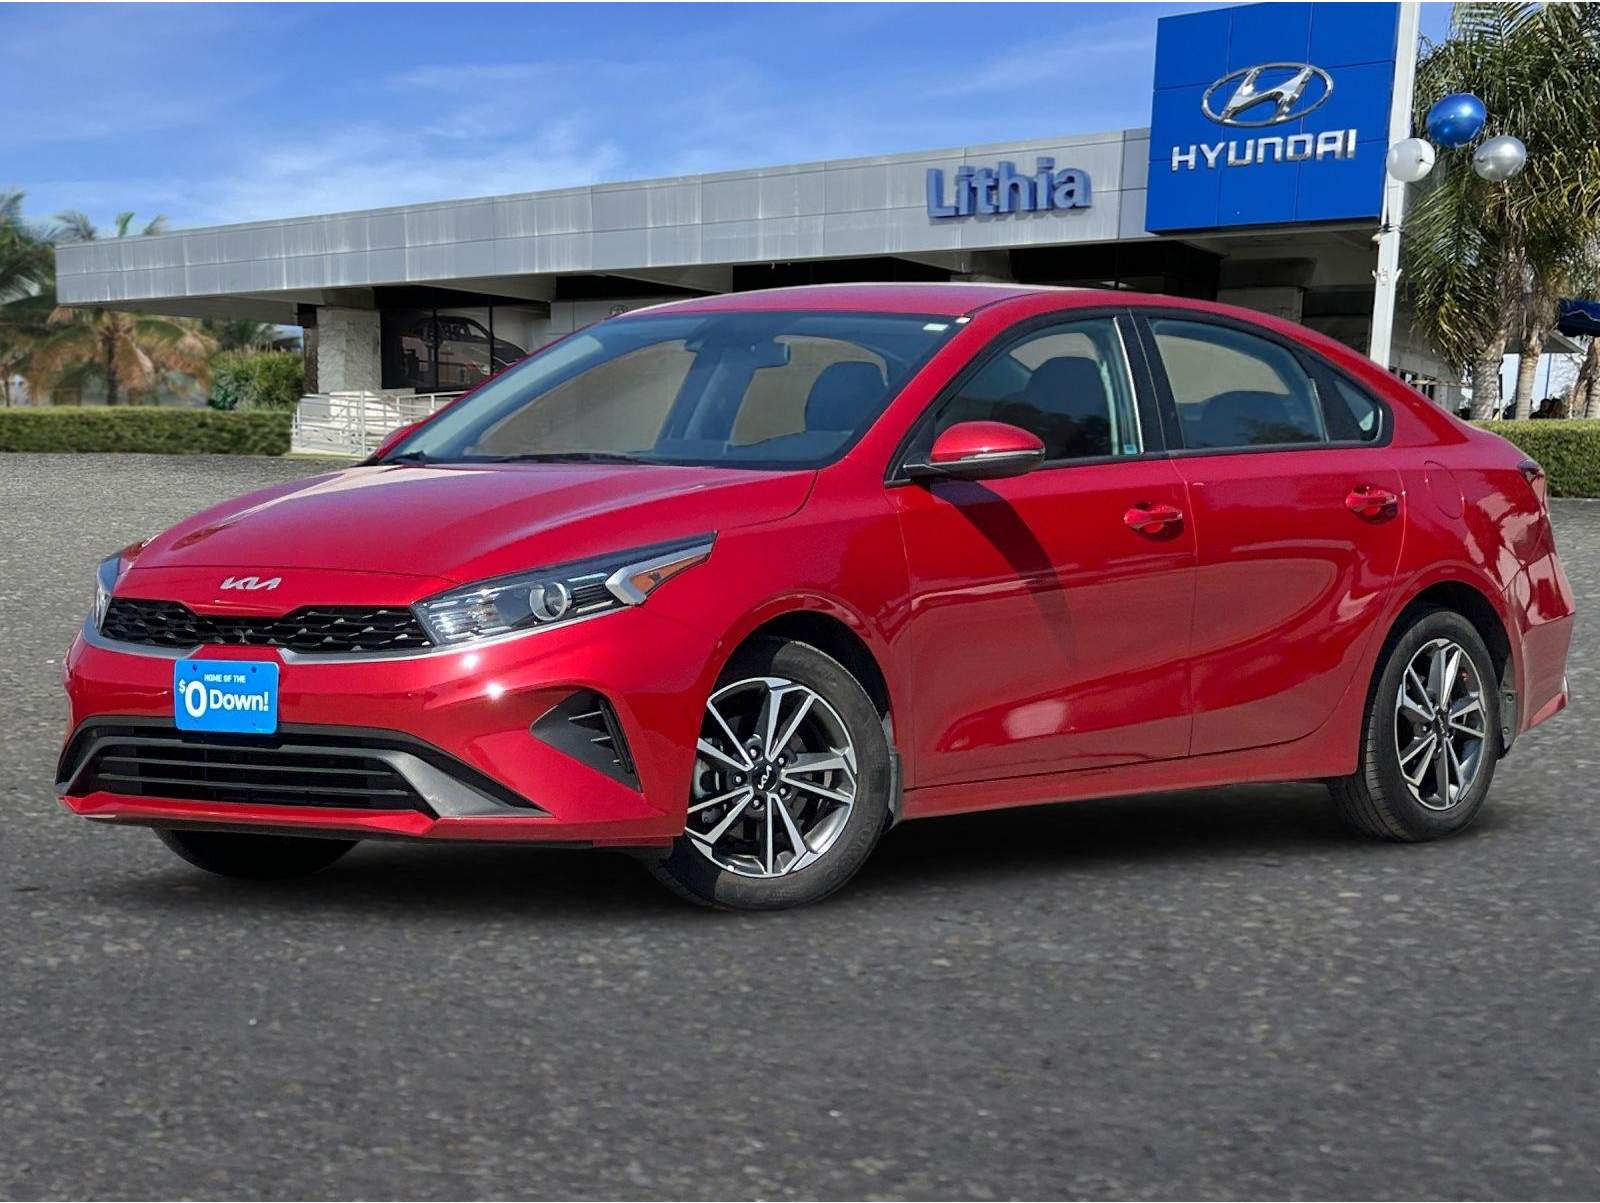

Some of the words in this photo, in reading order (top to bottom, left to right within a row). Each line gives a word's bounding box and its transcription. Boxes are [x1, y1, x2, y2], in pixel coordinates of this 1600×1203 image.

[1171, 129, 1357, 172] HYUNDAI
[927, 157, 1093, 217] Lithia
[204, 673, 222, 683] HOME
[223, 675, 232, 683] OF
[233, 675, 246, 683] THE
[209, 689, 269, 711] Down!
